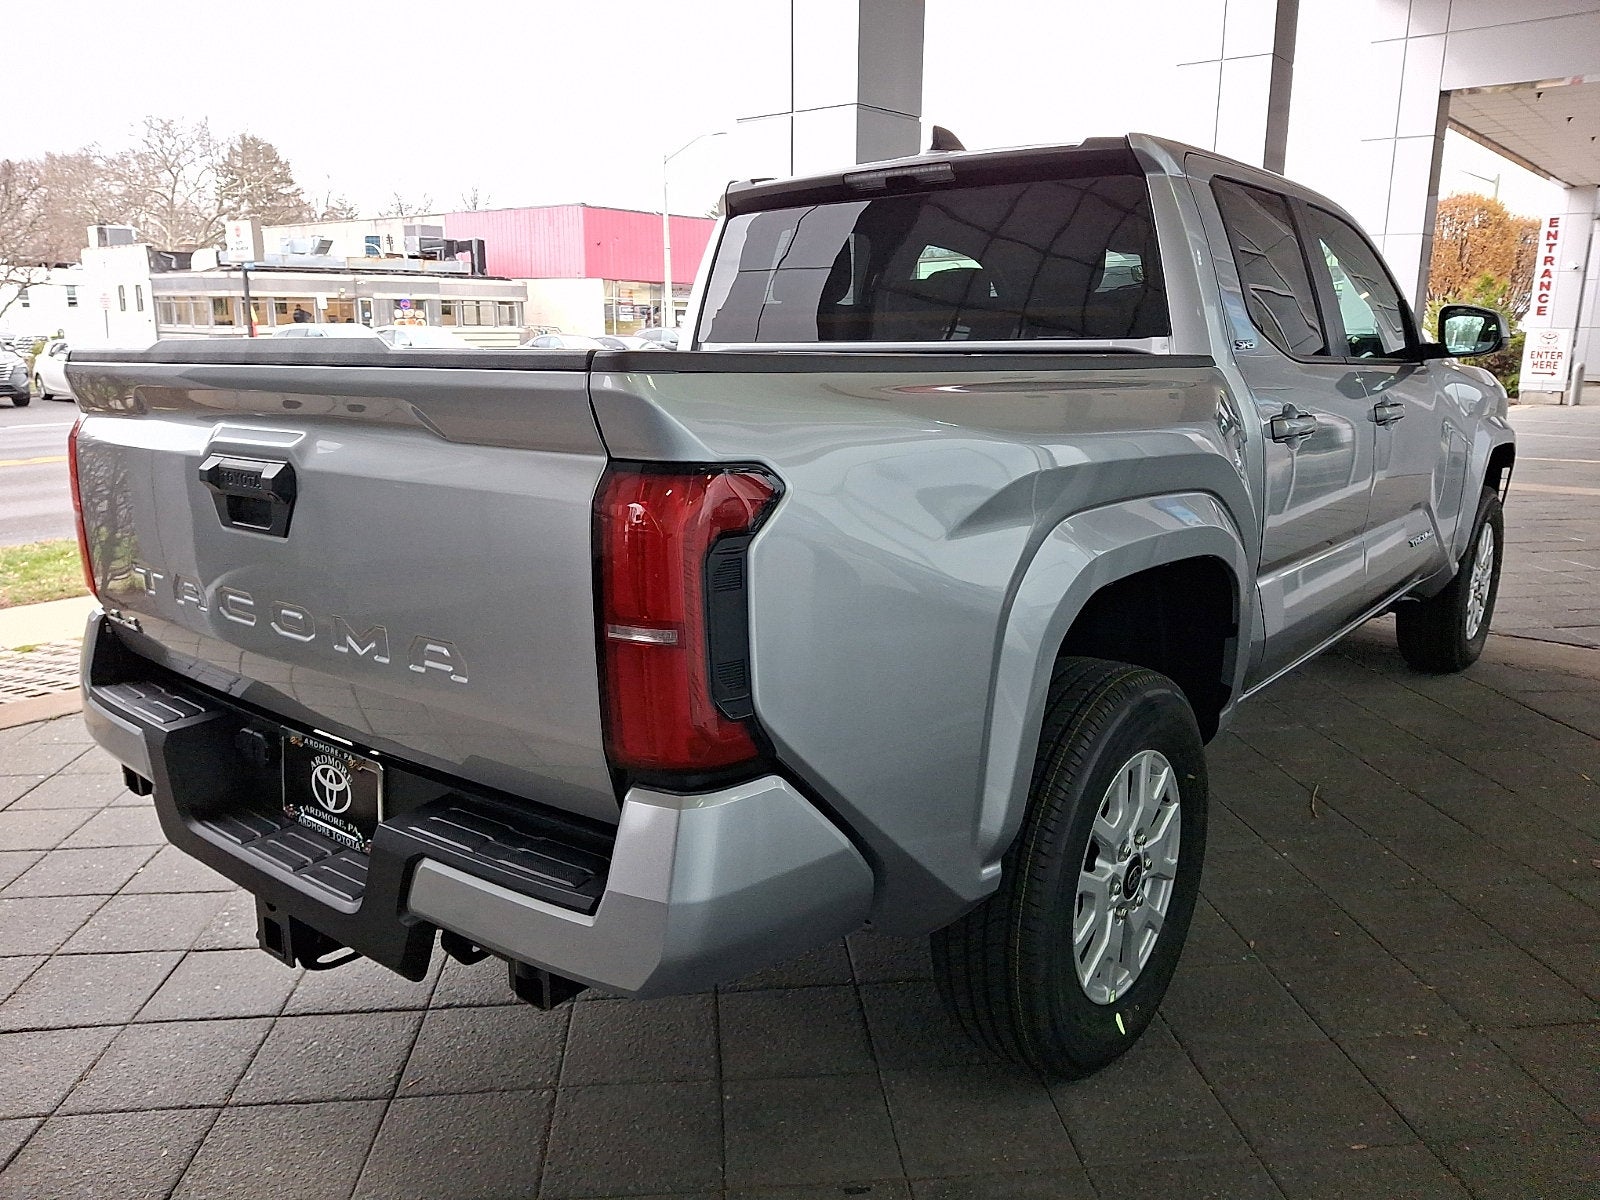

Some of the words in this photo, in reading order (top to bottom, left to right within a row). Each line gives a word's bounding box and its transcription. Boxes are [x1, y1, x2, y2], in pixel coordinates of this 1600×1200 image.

[1536, 217, 1560, 316] ENTRANCE
[1530, 350, 1563, 360] ENTER
[1531, 360, 1559, 370] HERE
[133, 563, 469, 684] TACOMA
[310, 754, 353, 786] ARDMORE
[298, 816, 331, 837] ARDMORE
[331, 830, 361, 851] TOYOTA
[304, 804, 347, 830] ARDMORE,
[347, 823, 359, 836] PA
